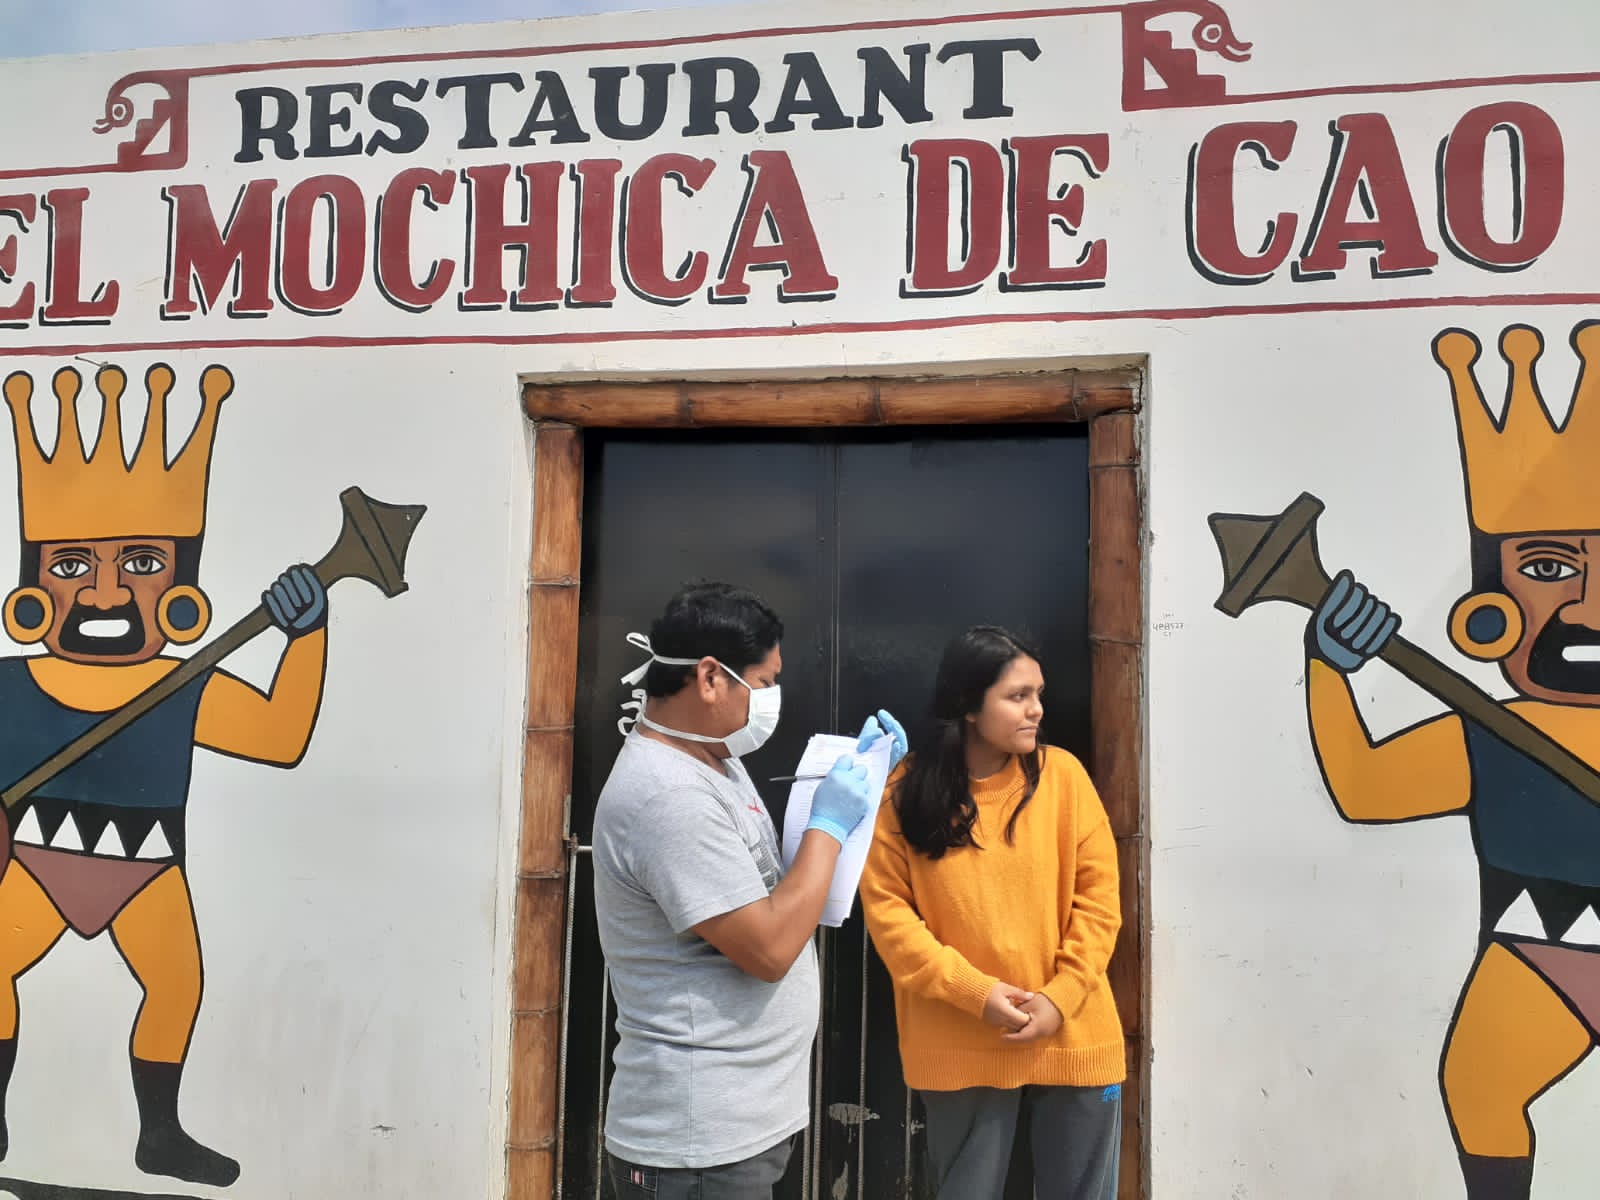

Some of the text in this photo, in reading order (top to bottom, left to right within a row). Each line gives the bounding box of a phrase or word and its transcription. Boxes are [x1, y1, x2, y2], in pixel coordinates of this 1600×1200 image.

[234, 38, 1041, 162] RESTAURANT
[160, 150, 839, 320] MOCHICA
[900, 133, 1109, 298] DE
[1186, 101, 1565, 286] CAO
